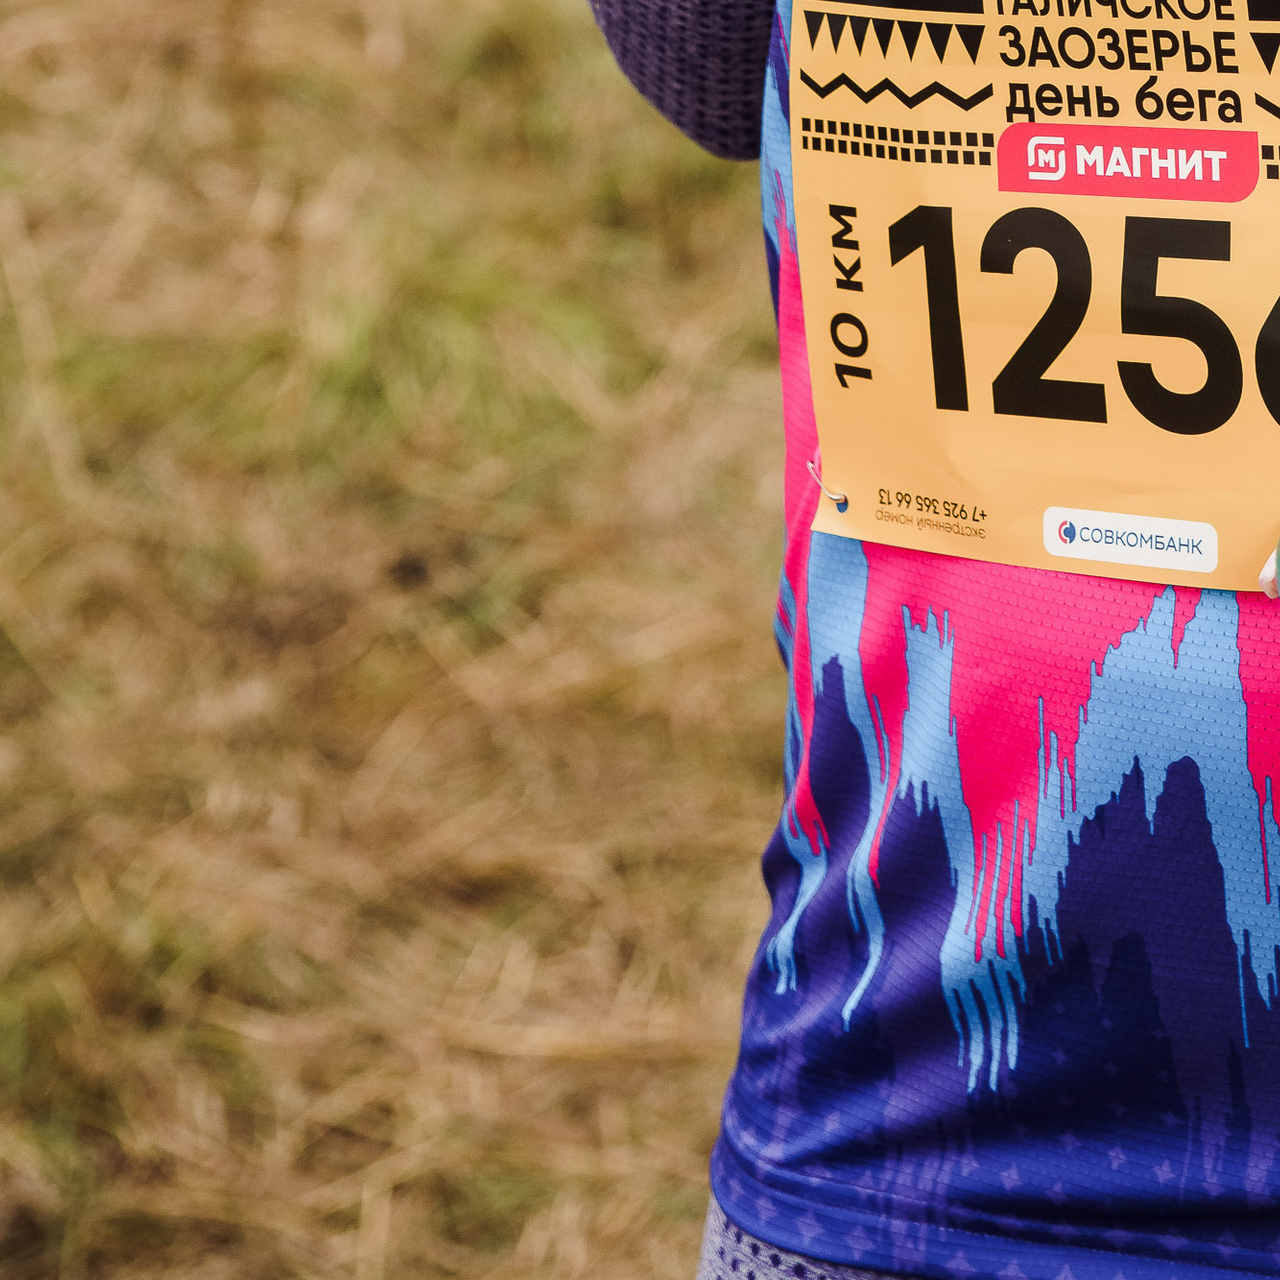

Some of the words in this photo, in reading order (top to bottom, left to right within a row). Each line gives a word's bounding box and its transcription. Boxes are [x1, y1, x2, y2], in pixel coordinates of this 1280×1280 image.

[998, 24, 1240, 74] ЗАОЗЕРЬЕ
[1005, 82, 1120, 124] день
[1135, 75, 1243, 124] бега
[1075, 144, 1228, 182] МАГНИТ
[828, 203, 865, 293] КМ
[830, 312, 873, 390] 10
[878, 488, 893, 506] 13
[895, 491, 912, 509] 66
[915, 495, 940, 515] 365
[942, 500, 968, 520] 925
[971, 505, 988, 523] +7
[1078, 526, 1204, 556] СОВКОМБАНК
